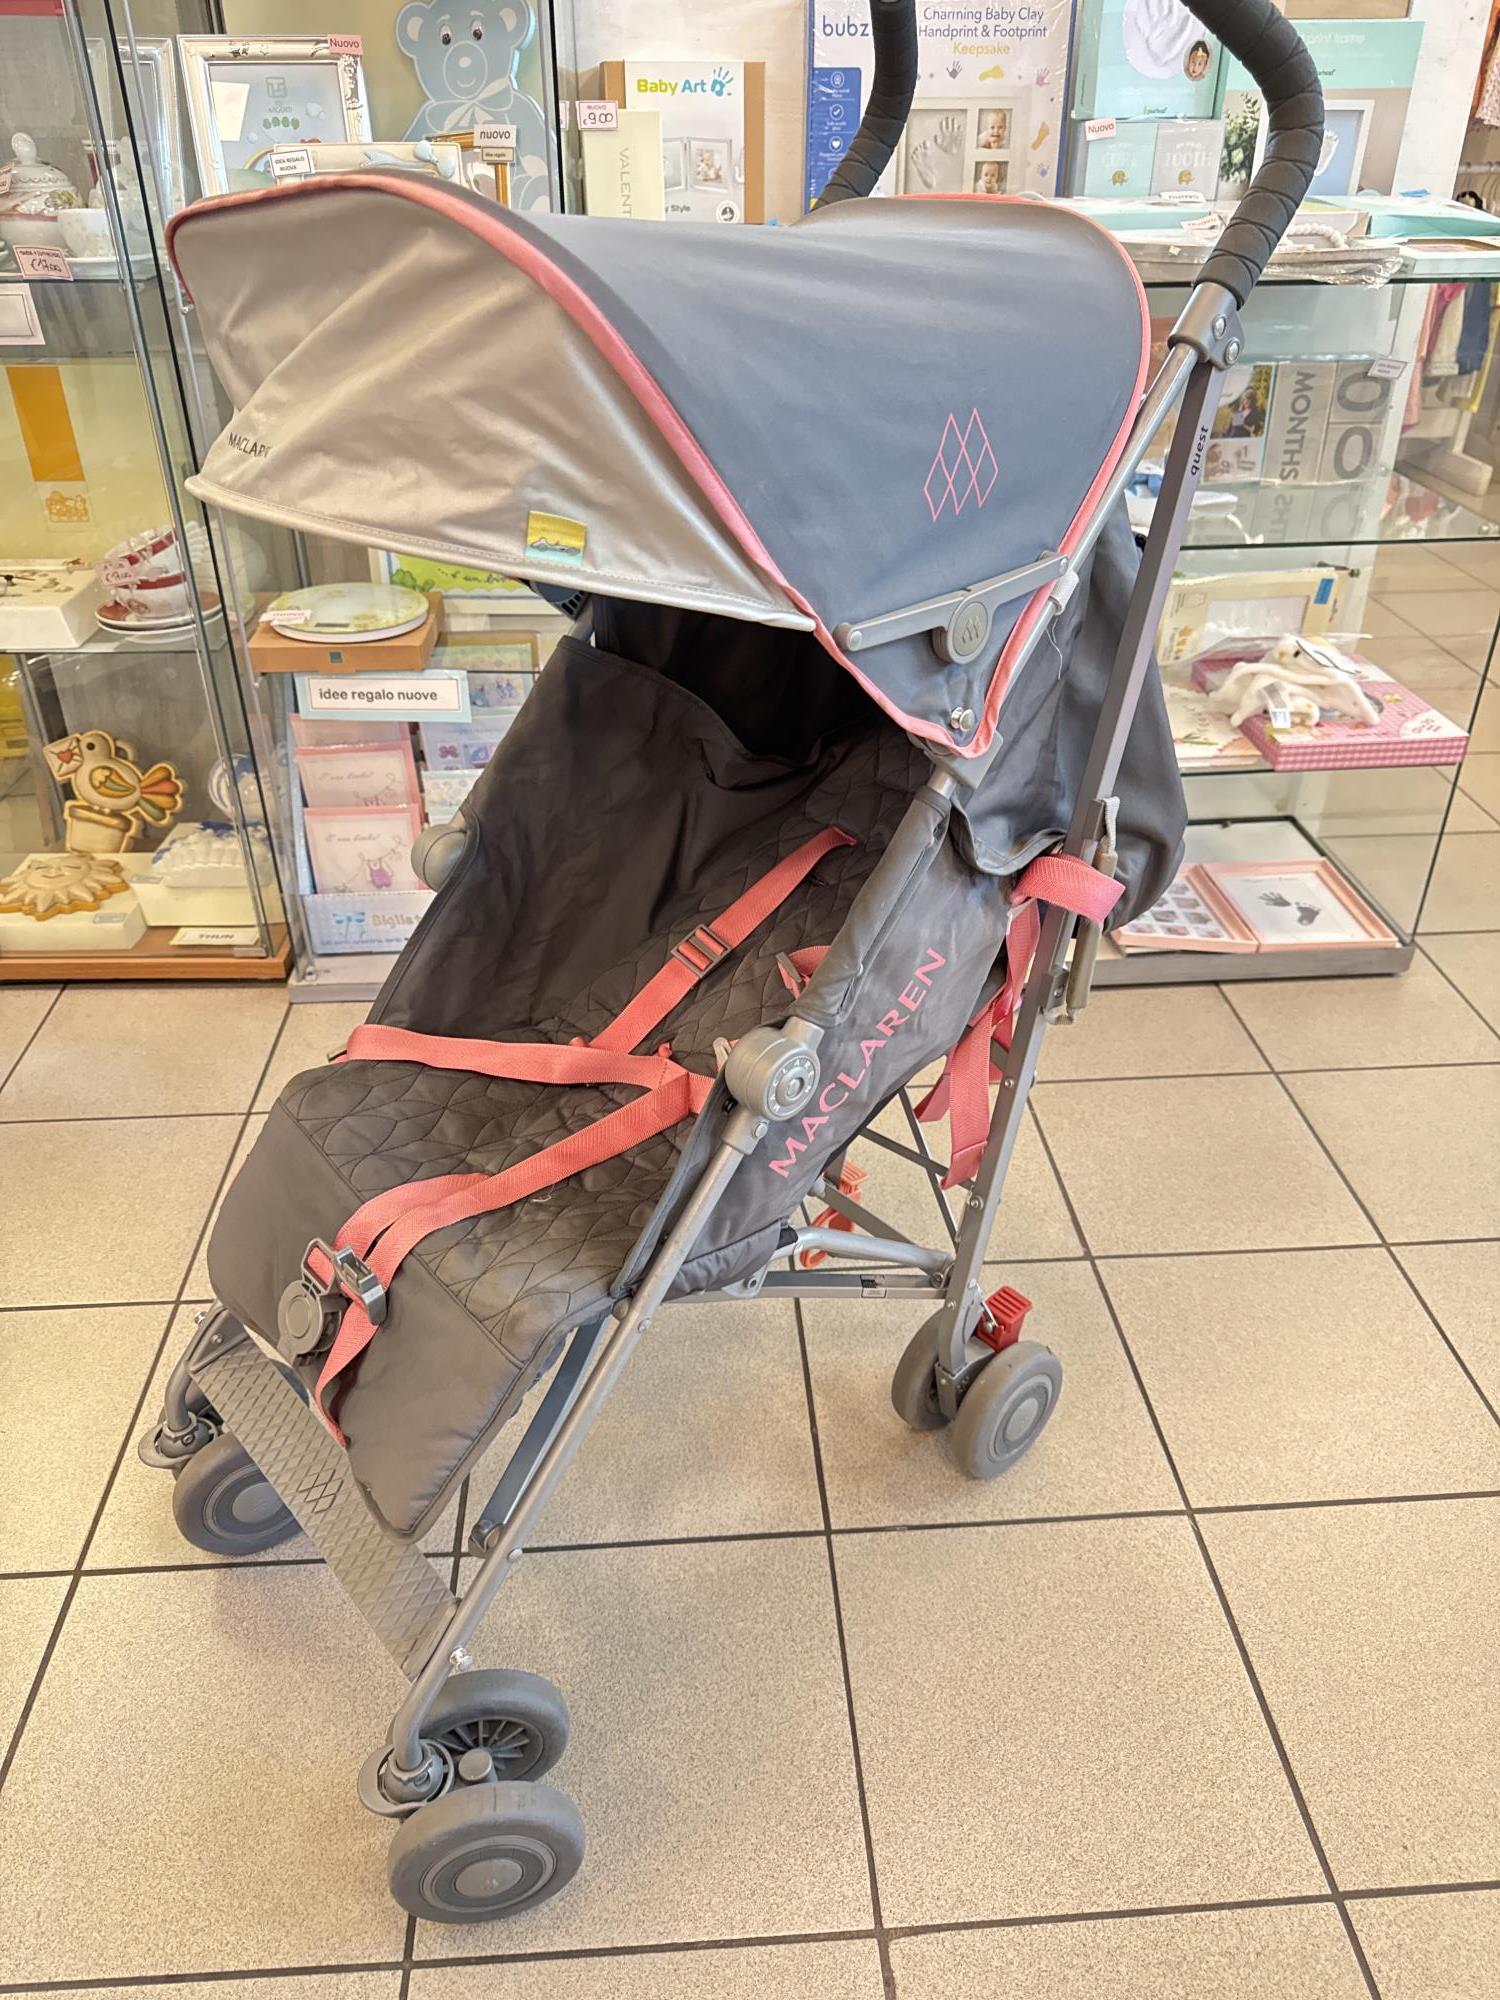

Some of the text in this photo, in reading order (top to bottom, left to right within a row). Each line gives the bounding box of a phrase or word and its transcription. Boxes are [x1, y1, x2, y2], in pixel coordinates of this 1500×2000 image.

[923, 7, 1044, 26] Charming Baby Clay
[822, 15, 870, 37] bubz
[918, 25, 1047, 41] Handprint & Footprint
[329, 38, 360, 49] Nuovo
[952, 42, 1010, 56] Keepsake
[636, 78, 707, 96] Baby Art
[480, 130, 511, 140] nuovo
[1088, 123, 1115, 133] Nuovo
[1280, 372, 1315, 480] MONTHS
[1190, 425, 1209, 476] quest
[319, 688, 438, 704] idee regalo nuove
[768, 947, 947, 1179] MACLAREN
